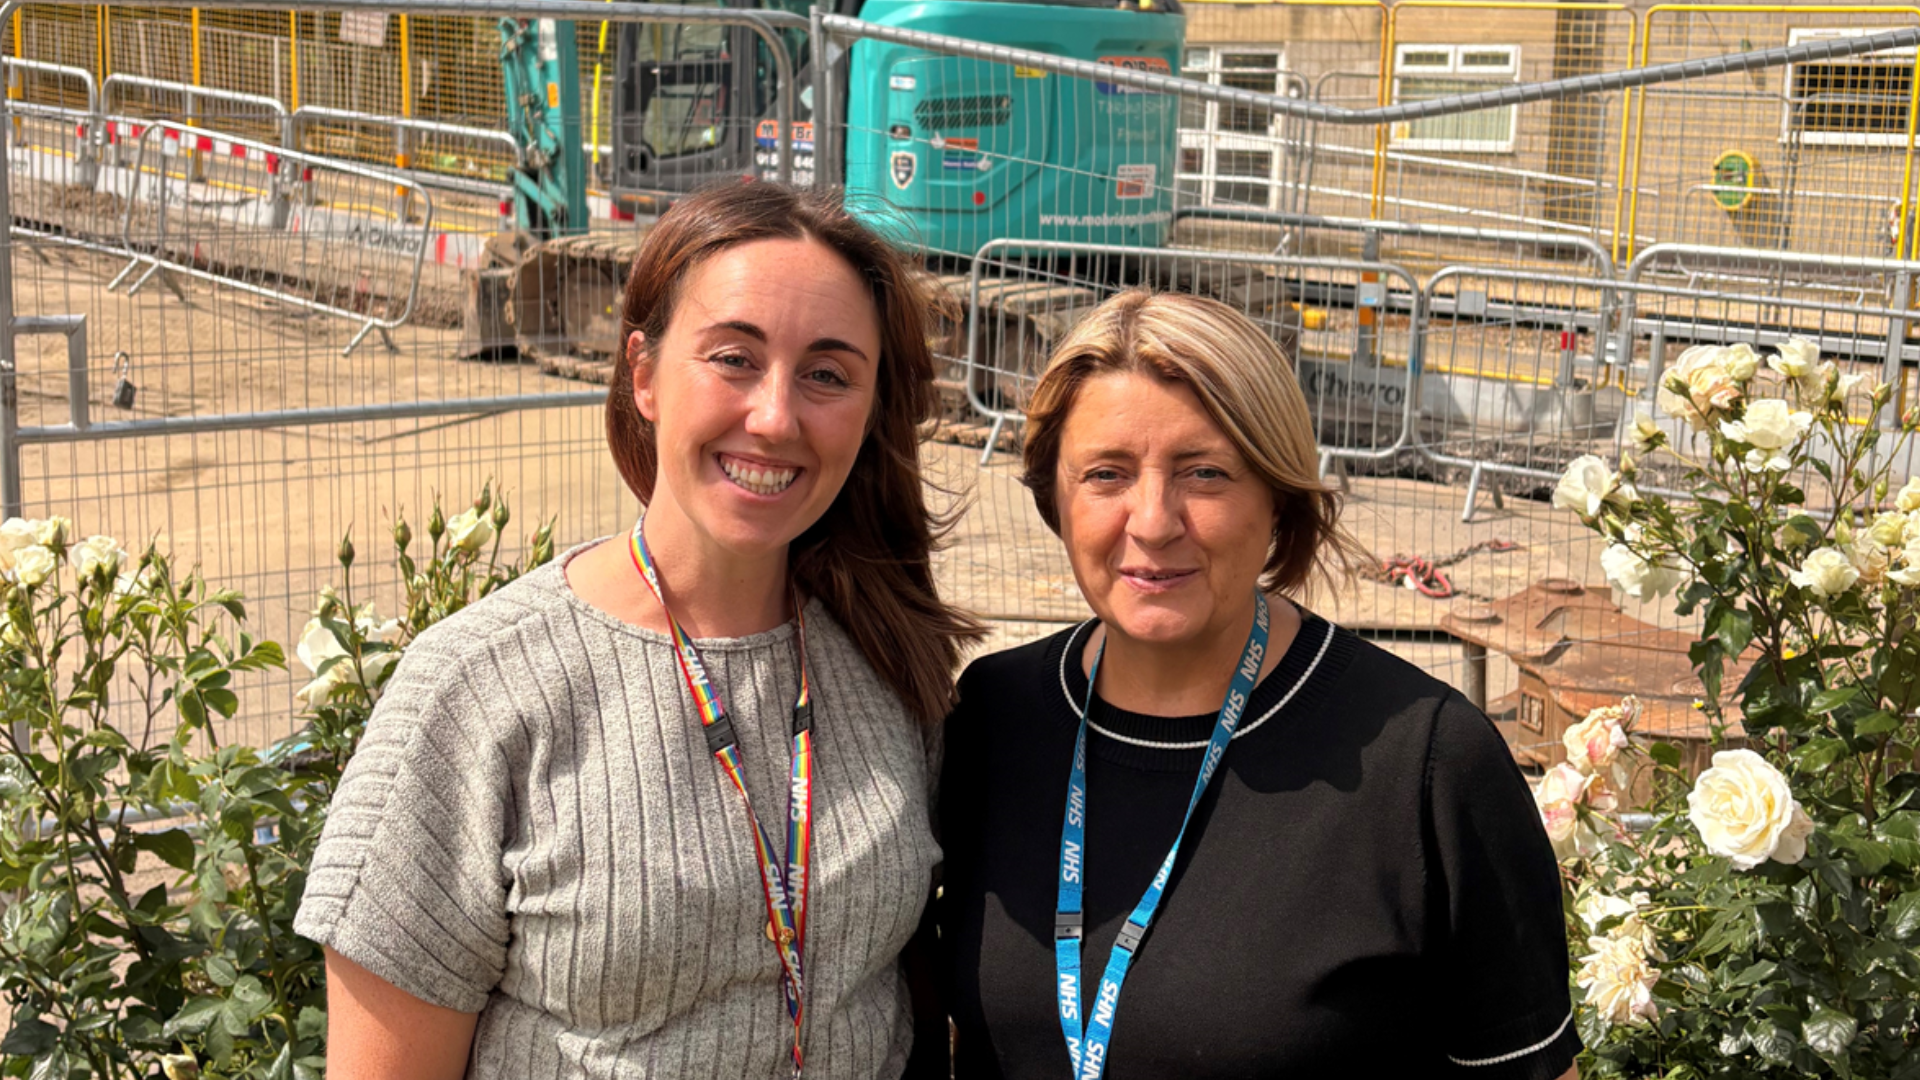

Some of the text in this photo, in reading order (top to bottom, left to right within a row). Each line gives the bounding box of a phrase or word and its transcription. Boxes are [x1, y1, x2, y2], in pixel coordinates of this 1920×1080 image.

[679, 644, 710, 687] NHS
[1240, 639, 1264, 682] NHS
[1221, 688, 1245, 734] NHS
[1202, 742, 1223, 784] NHS
[791, 777, 808, 823] NHS
[1068, 785, 1083, 828] NHS
[1063, 840, 1081, 884] NHS
[764, 863, 788, 911] NHS
[1060, 973, 1079, 1020] NHS
[1094, 979, 1119, 1028] NHS
[1081, 1039, 1104, 1080] NHS
